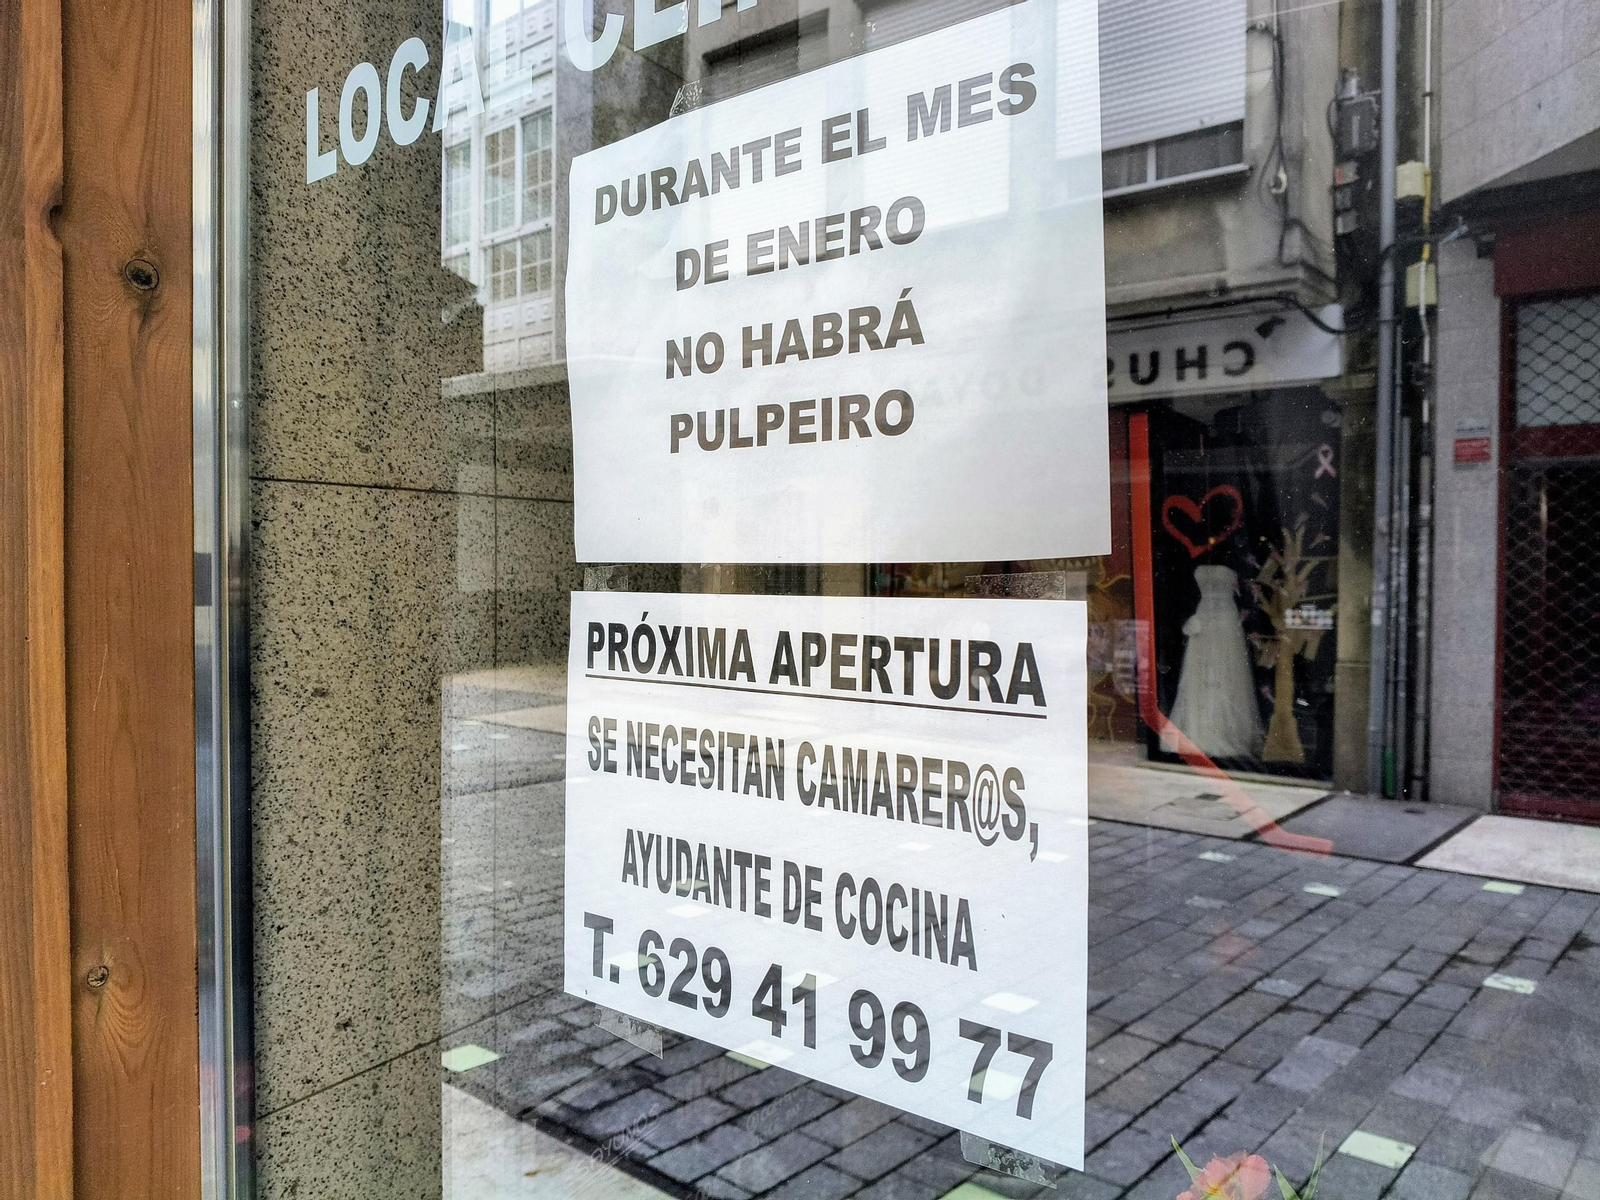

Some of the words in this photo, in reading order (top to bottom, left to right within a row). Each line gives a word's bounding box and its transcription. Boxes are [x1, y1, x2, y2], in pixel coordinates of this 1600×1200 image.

[306, 0, 533, 185] LOCAL
[594, 126, 803, 226] DURANTE
[821, 107, 888, 165] EL
[906, 62, 1038, 143] MES
[675, 238, 730, 292] DE
[746, 195, 926, 277] ENERO
[665, 331, 725, 380] NO
[741, 286, 926, 369] HABRÁ
[669, 388, 915, 454] PULPEIRO
[586, 611, 757, 684] PRÓXIMA
[768, 630, 1048, 708] APERTURA
[587, 715, 618, 774] SE
[626, 720, 785, 802] NECESITAN
[796, 740, 1039, 864] CAMARER@S,
[621, 827, 773, 919] AYUDANTE
[782, 859, 824, 933] DE
[834, 871, 978, 973] COCINA
[583, 911, 621, 985] T.
[637, 928, 733, 1019] 629
[751, 962, 818, 1051] 41
[848, 988, 931, 1084] 99
[958, 1017, 1054, 1121] 77
